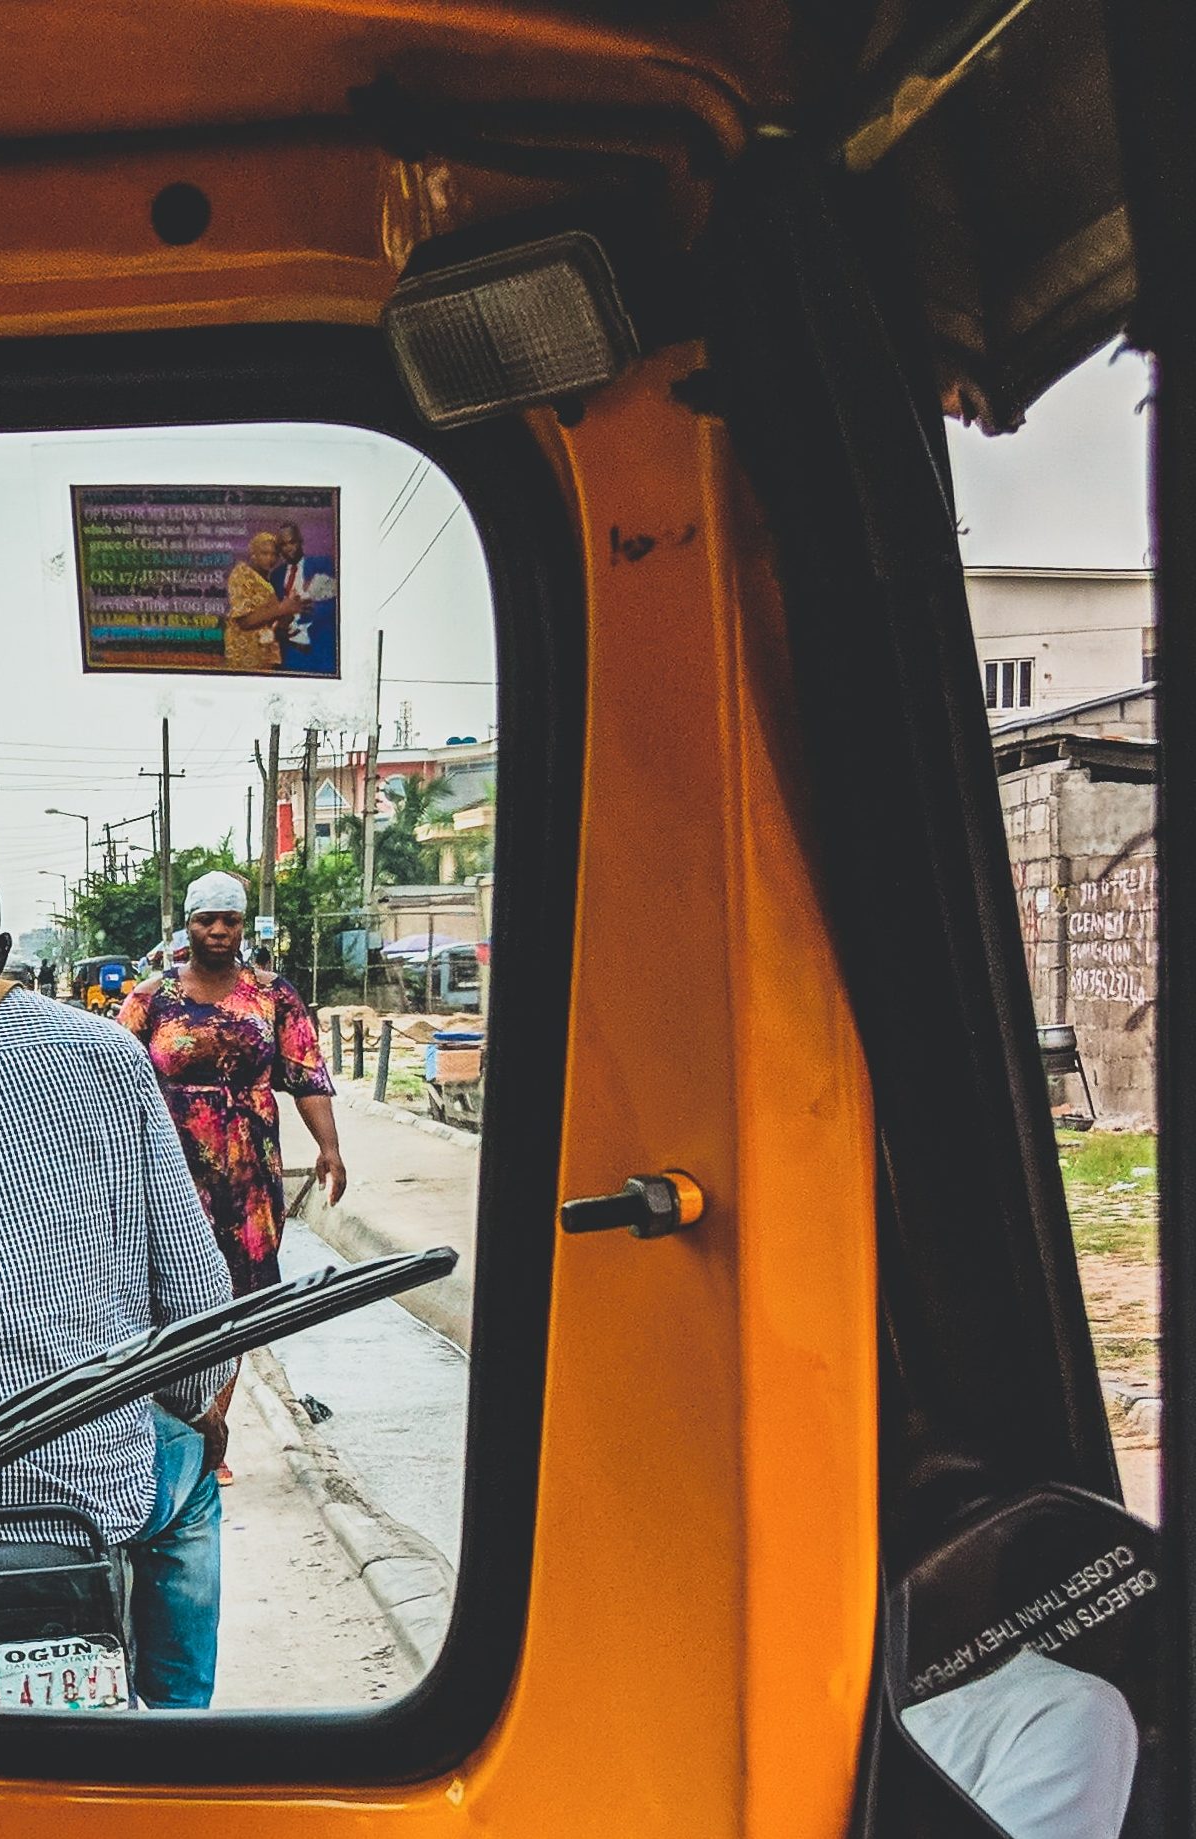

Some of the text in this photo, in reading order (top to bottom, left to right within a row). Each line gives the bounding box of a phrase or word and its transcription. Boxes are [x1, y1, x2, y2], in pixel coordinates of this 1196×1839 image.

[89, 540, 121, 552] grace
[124, 537, 138, 550] of
[141, 538, 168, 550] God
[113, 523, 133, 535] will
[90, 570, 113, 581] ON
[1060, 1546, 1135, 1599] CLOSER
[1015, 1590, 1068, 1628] THAN
[1076, 1569, 1157, 1628] OBJECTS
[974, 1619, 1022, 1657] THEY
[1055, 1617, 1081, 1641] IN
[5, 1642, 92, 1663] OGUN
[908, 1645, 976, 1696] APPEAR
